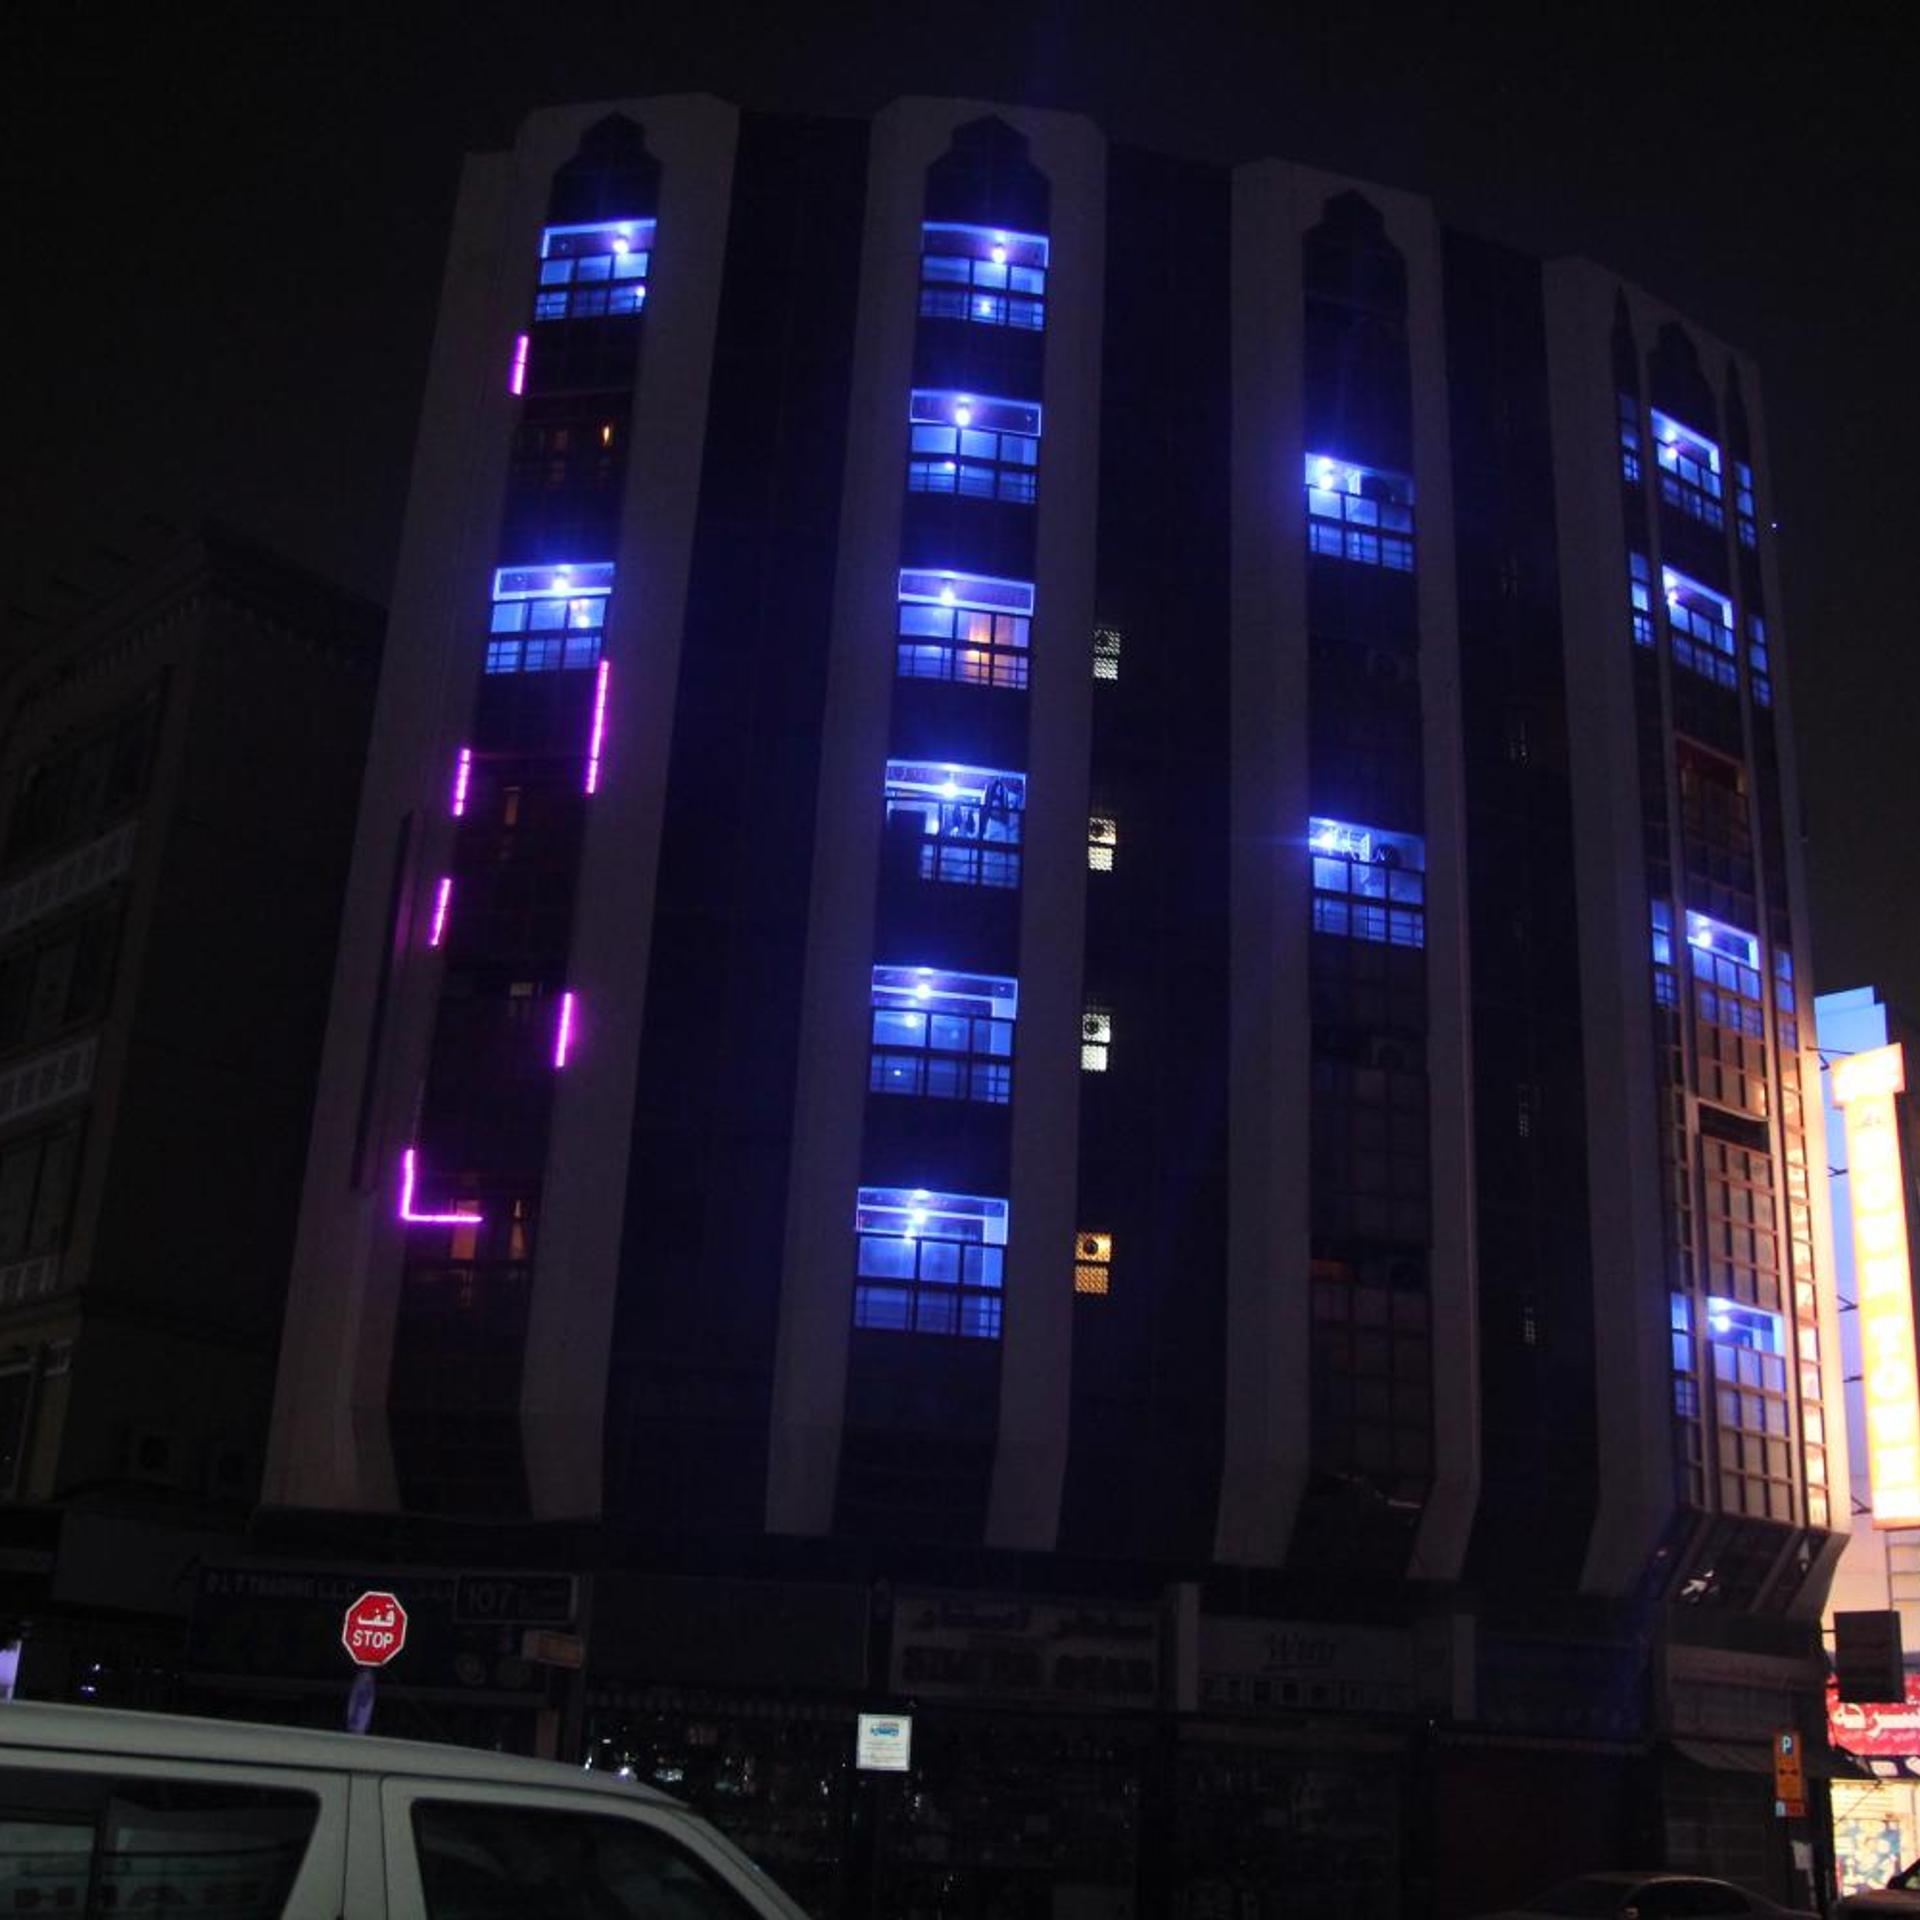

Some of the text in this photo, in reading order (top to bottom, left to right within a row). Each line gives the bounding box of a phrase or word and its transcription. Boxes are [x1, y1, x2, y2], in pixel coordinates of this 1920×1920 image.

[356, 1603, 396, 1627] قف
[352, 1629, 395, 1650] STOP
[1781, 1735, 1793, 1754] P
